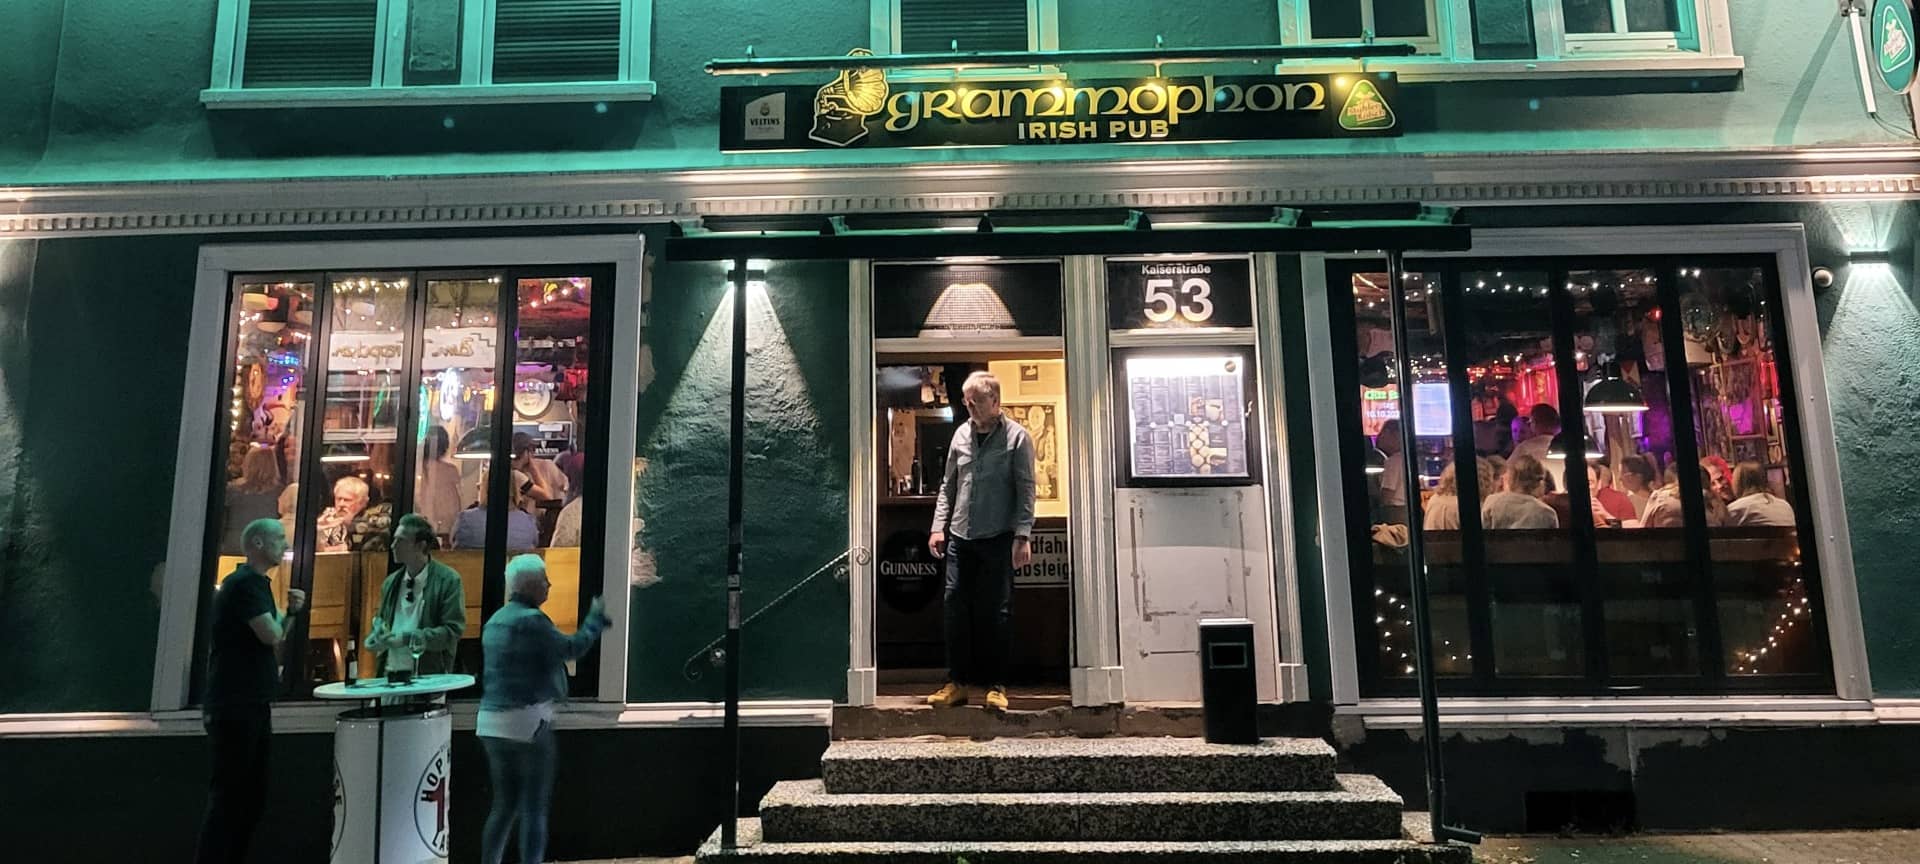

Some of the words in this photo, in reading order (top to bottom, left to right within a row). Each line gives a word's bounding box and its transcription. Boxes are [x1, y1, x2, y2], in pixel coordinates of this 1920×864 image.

[885, 76, 1325, 132] grammophon
[1018, 121, 1098, 140] IRISH
[1109, 120, 1169, 138] PUB
[1141, 264, 1211, 275] Kaiserstraße
[1143, 278, 1213, 322] 53
[880, 560, 937, 576] GUINNESS
